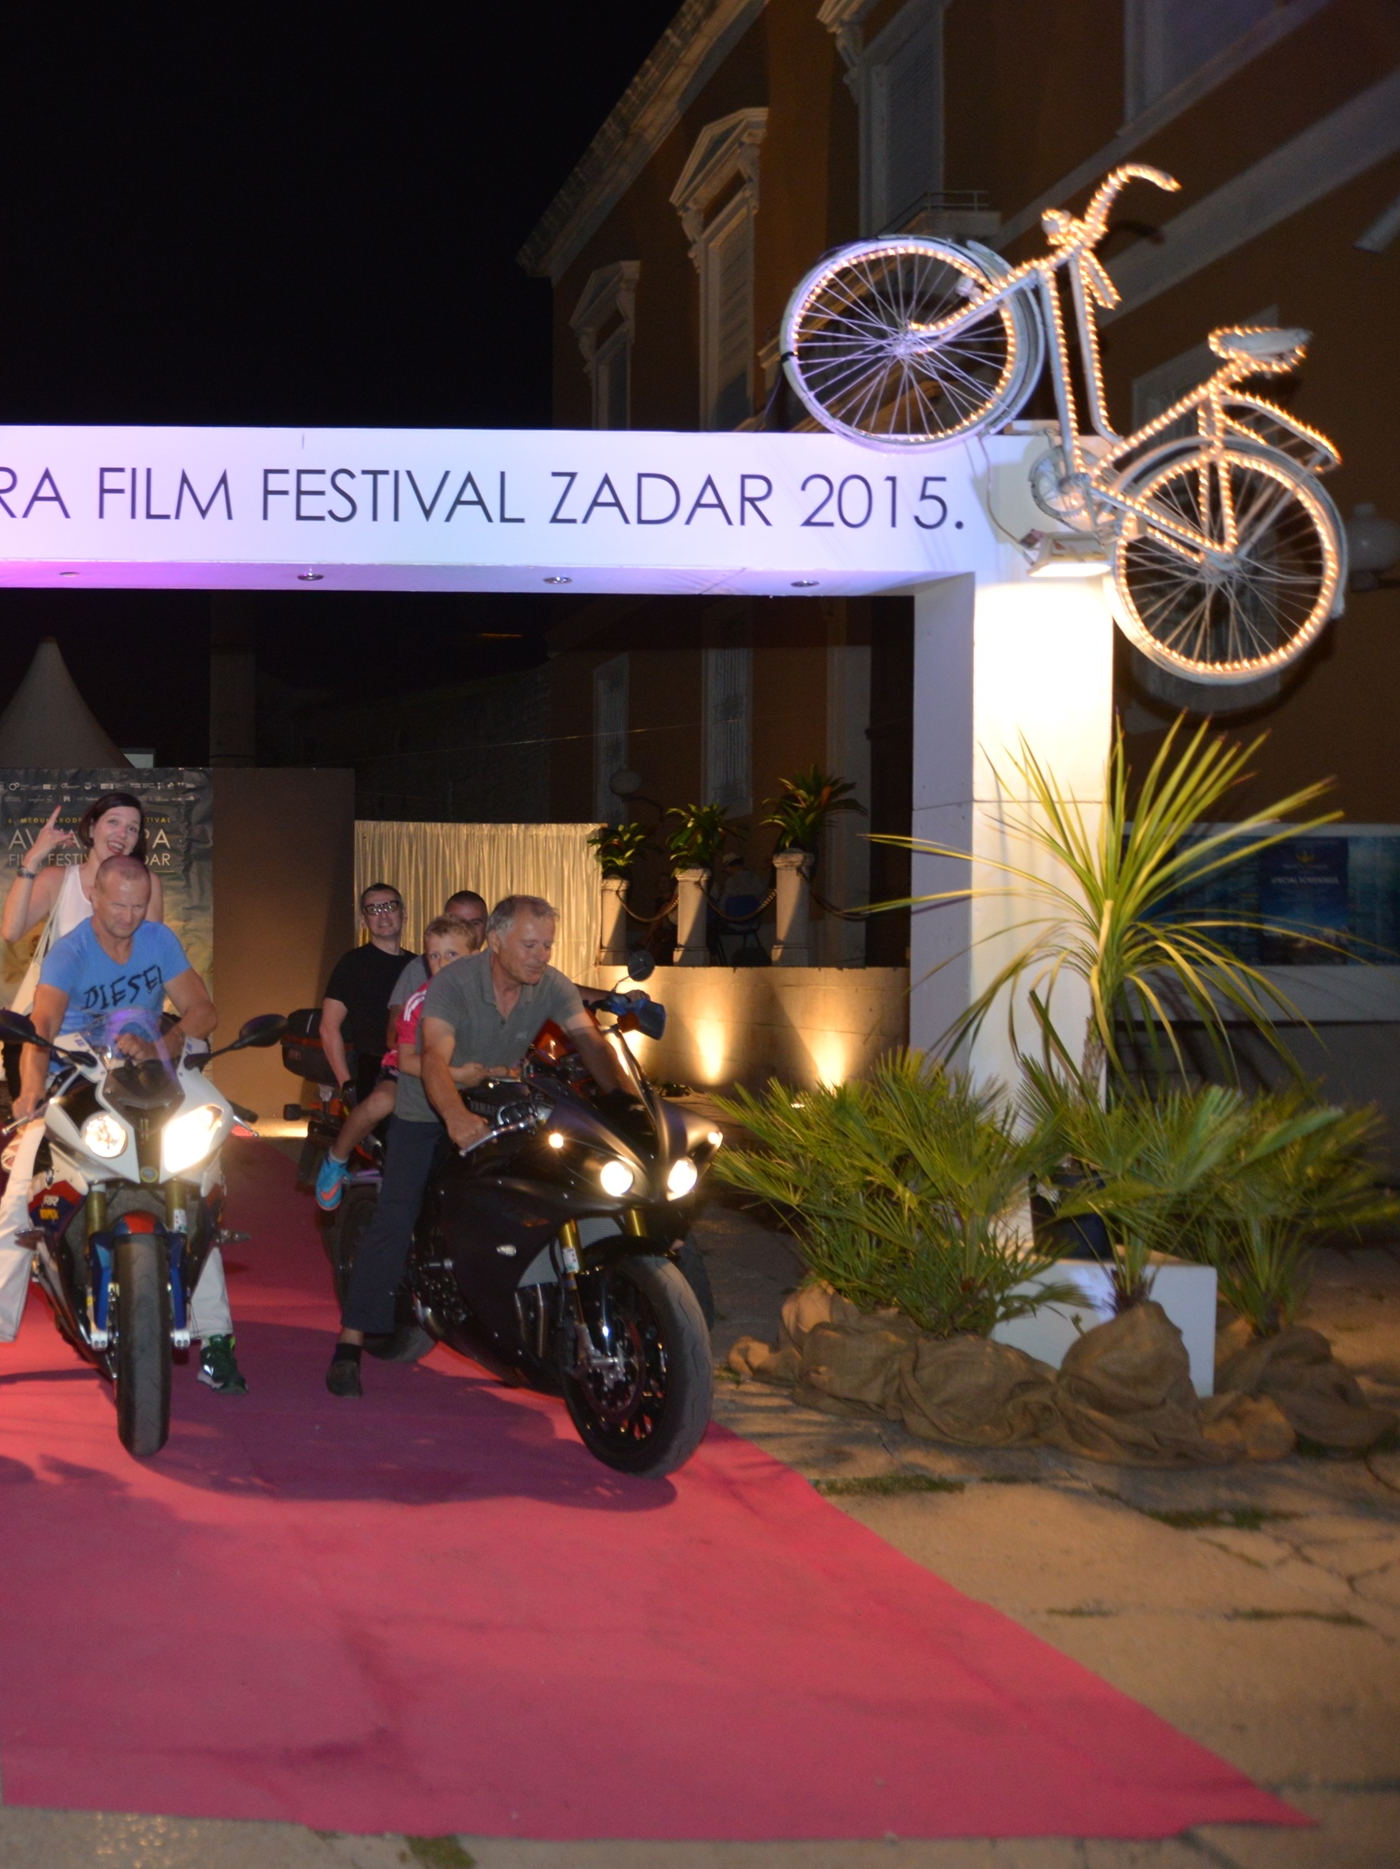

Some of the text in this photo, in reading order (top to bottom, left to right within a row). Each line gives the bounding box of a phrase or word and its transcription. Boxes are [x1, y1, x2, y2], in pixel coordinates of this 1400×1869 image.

[98, 467, 233, 521] FILM
[262, 468, 525, 524] FESTIVAL
[549, 471, 773, 526] ZADAR
[801, 473, 964, 530] 2015.
